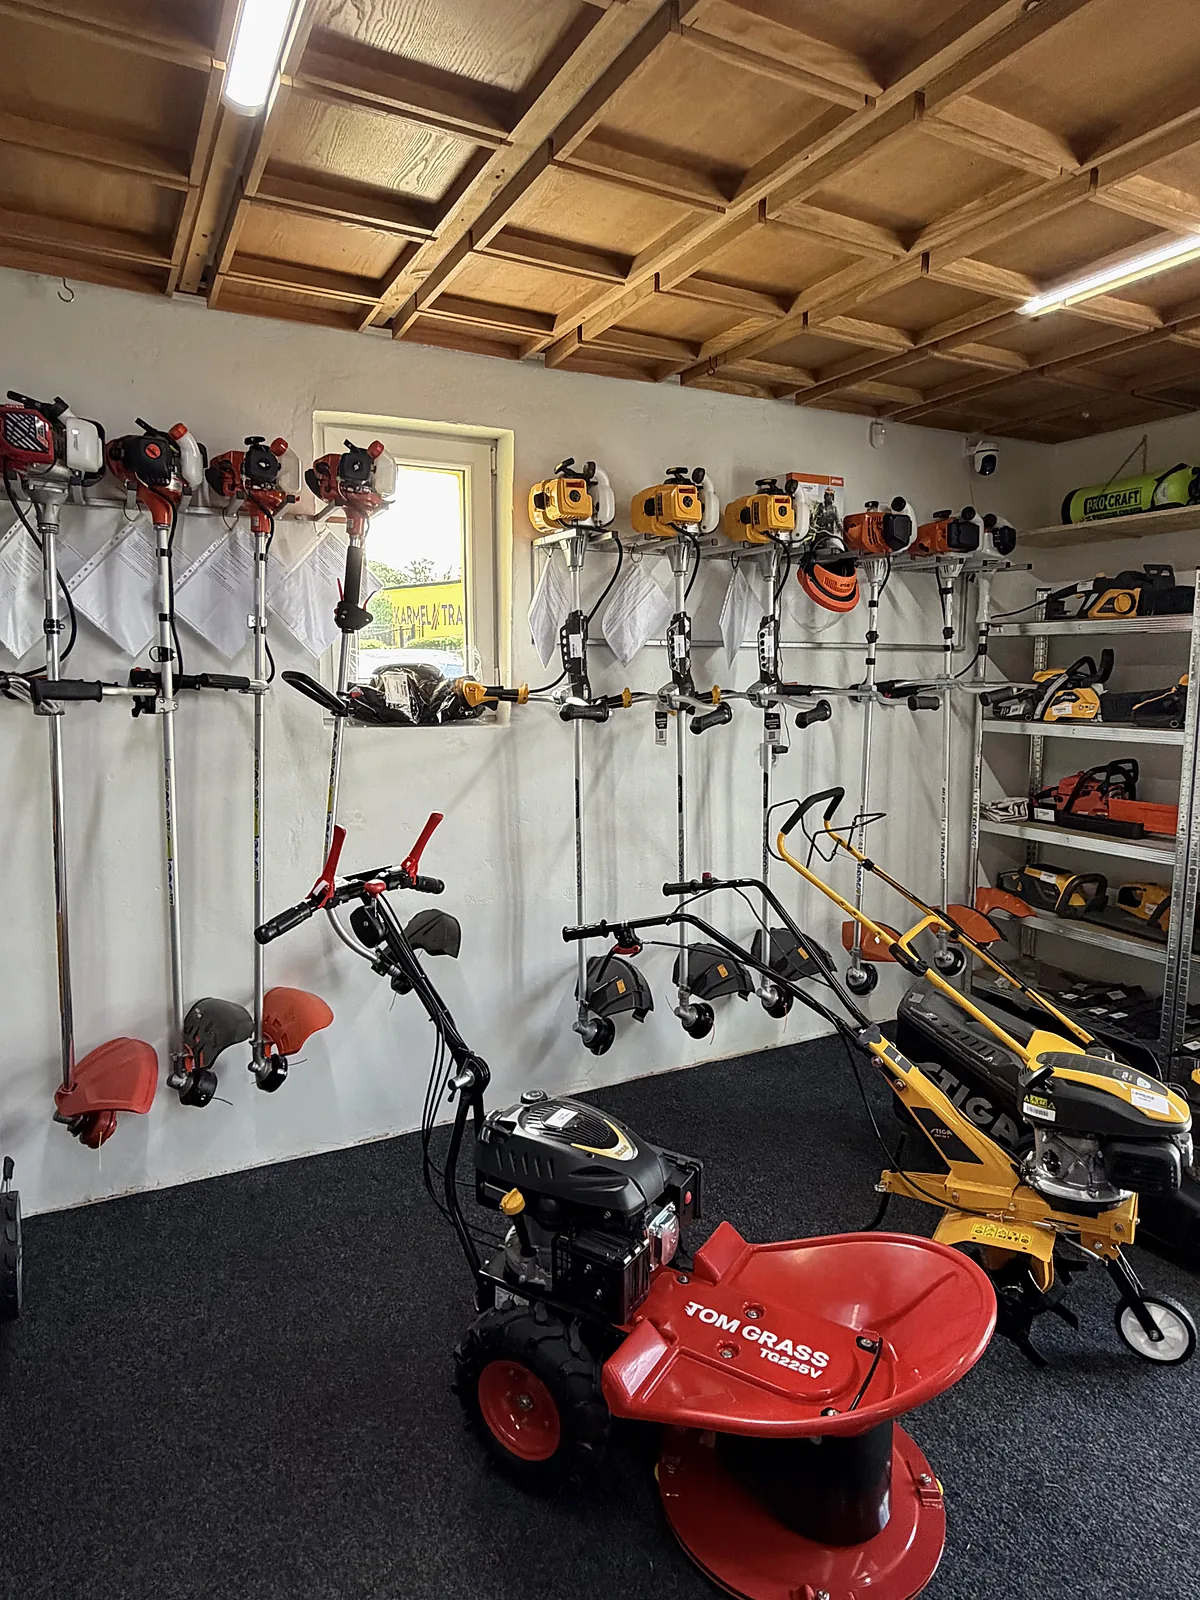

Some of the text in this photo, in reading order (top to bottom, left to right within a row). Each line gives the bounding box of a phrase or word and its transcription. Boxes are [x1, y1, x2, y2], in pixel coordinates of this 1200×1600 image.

[684, 1301, 830, 1368] TOM GRASS
[759, 1347, 823, 1379] TG225V
